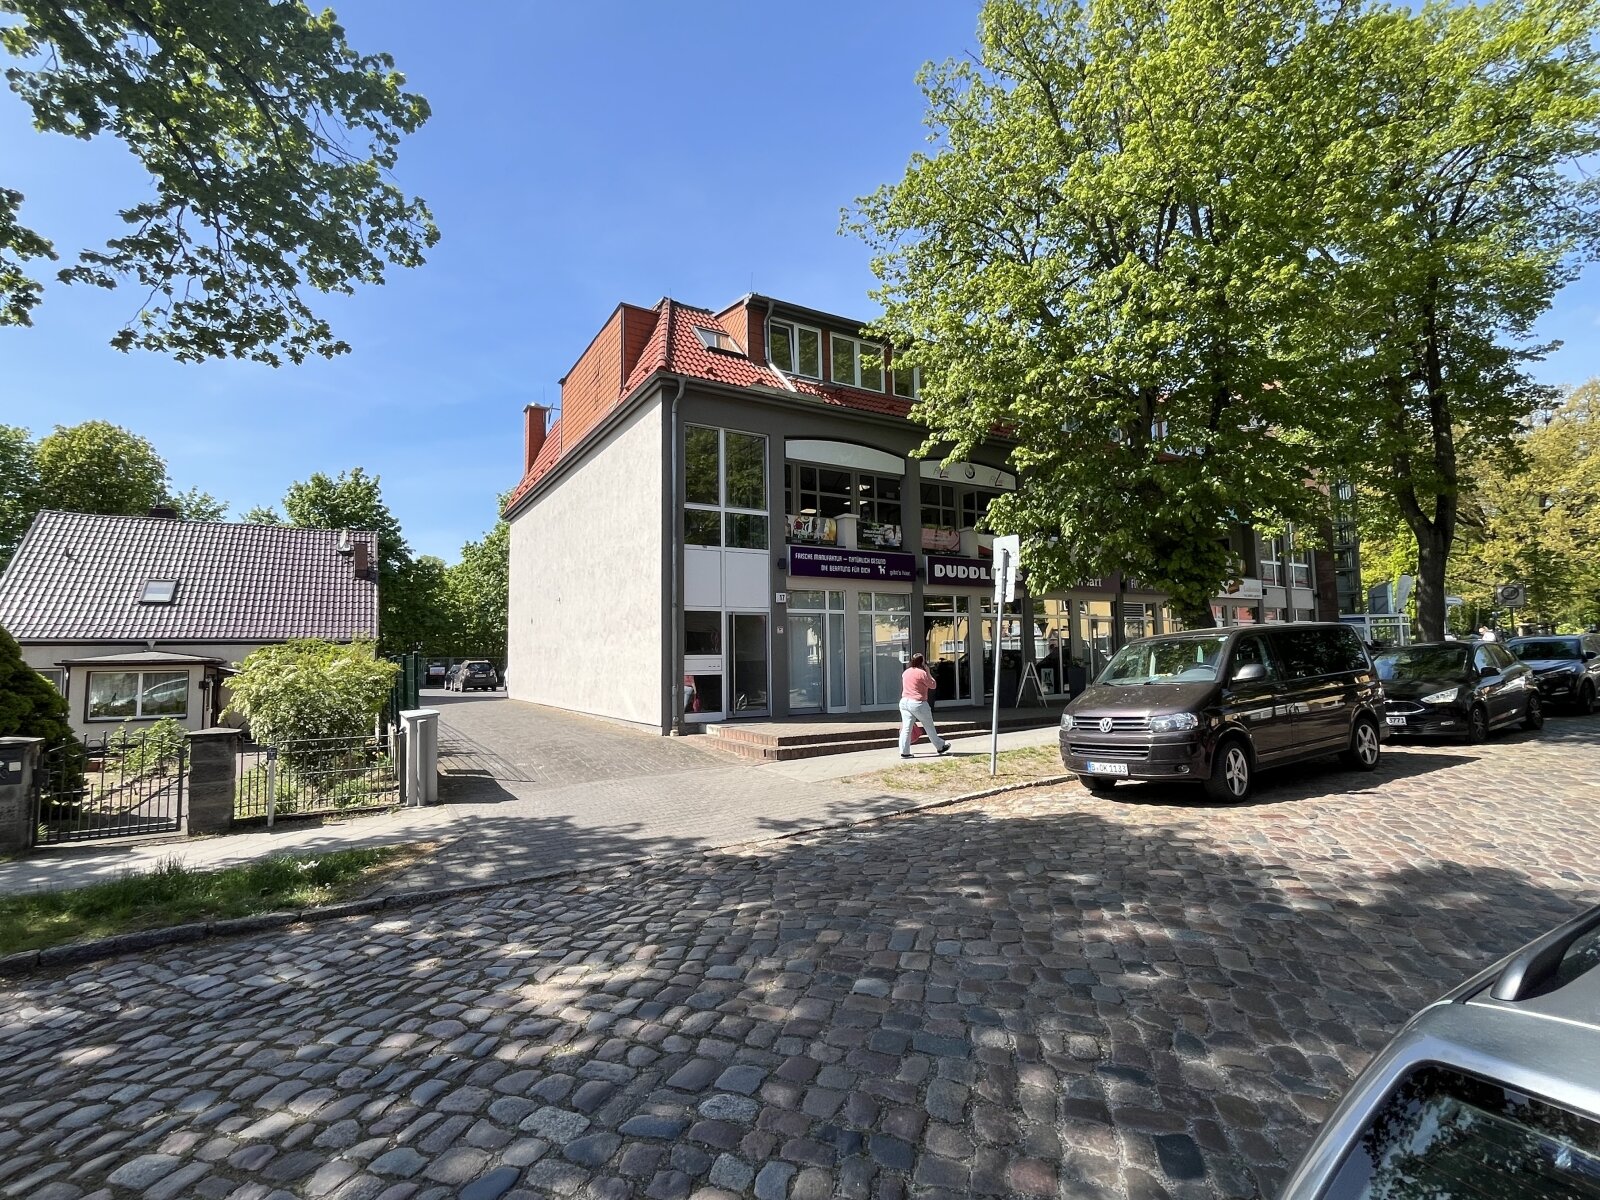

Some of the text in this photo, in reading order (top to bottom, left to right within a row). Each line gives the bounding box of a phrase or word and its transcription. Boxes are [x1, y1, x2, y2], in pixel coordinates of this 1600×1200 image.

[795, 552, 813, 560] FRISCHE
[814, 553, 842, 562] MANUFAKTUR
[848, 555, 871, 564] NATÜRLICH
[829, 565, 851, 573] BERATUNG
[860, 566, 871, 574] DICH
